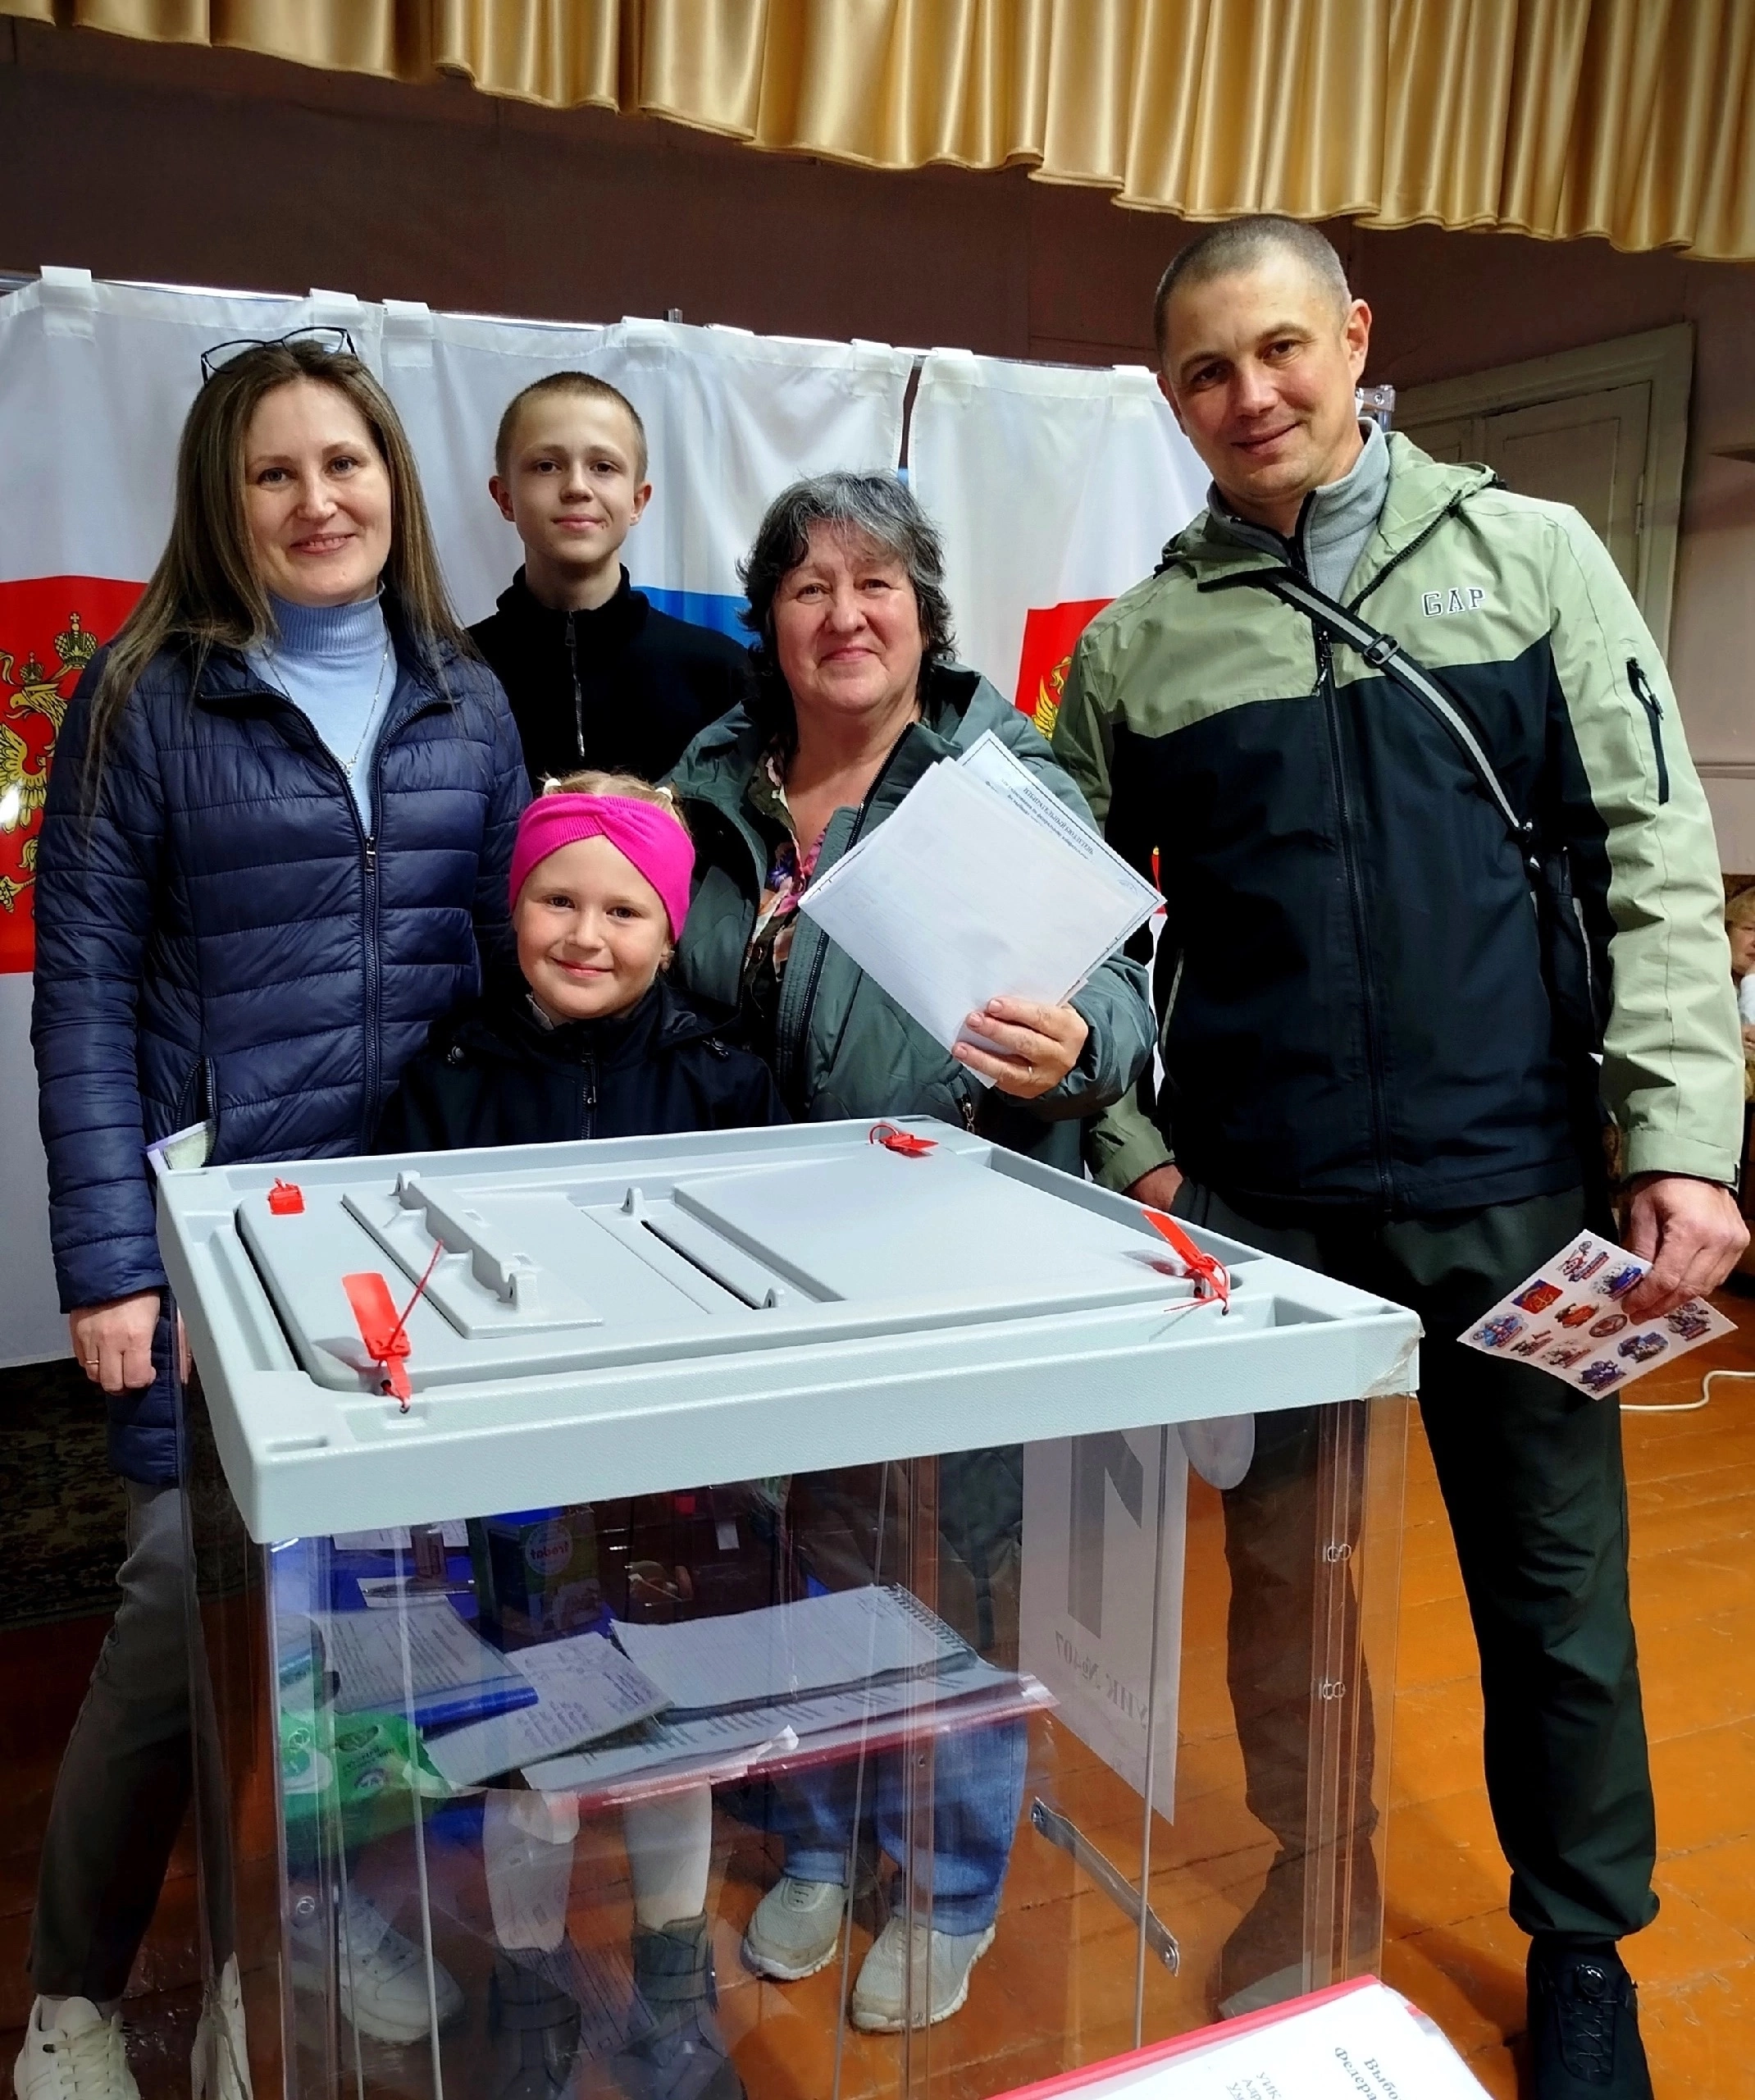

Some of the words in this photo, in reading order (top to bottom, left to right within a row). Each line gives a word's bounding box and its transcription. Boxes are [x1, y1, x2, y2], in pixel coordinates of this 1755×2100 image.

[1421, 587, 1485, 617] GAP
[1256, 2071, 1281, 2099] УИК
[1364, 2057, 1402, 2100] Выбо
